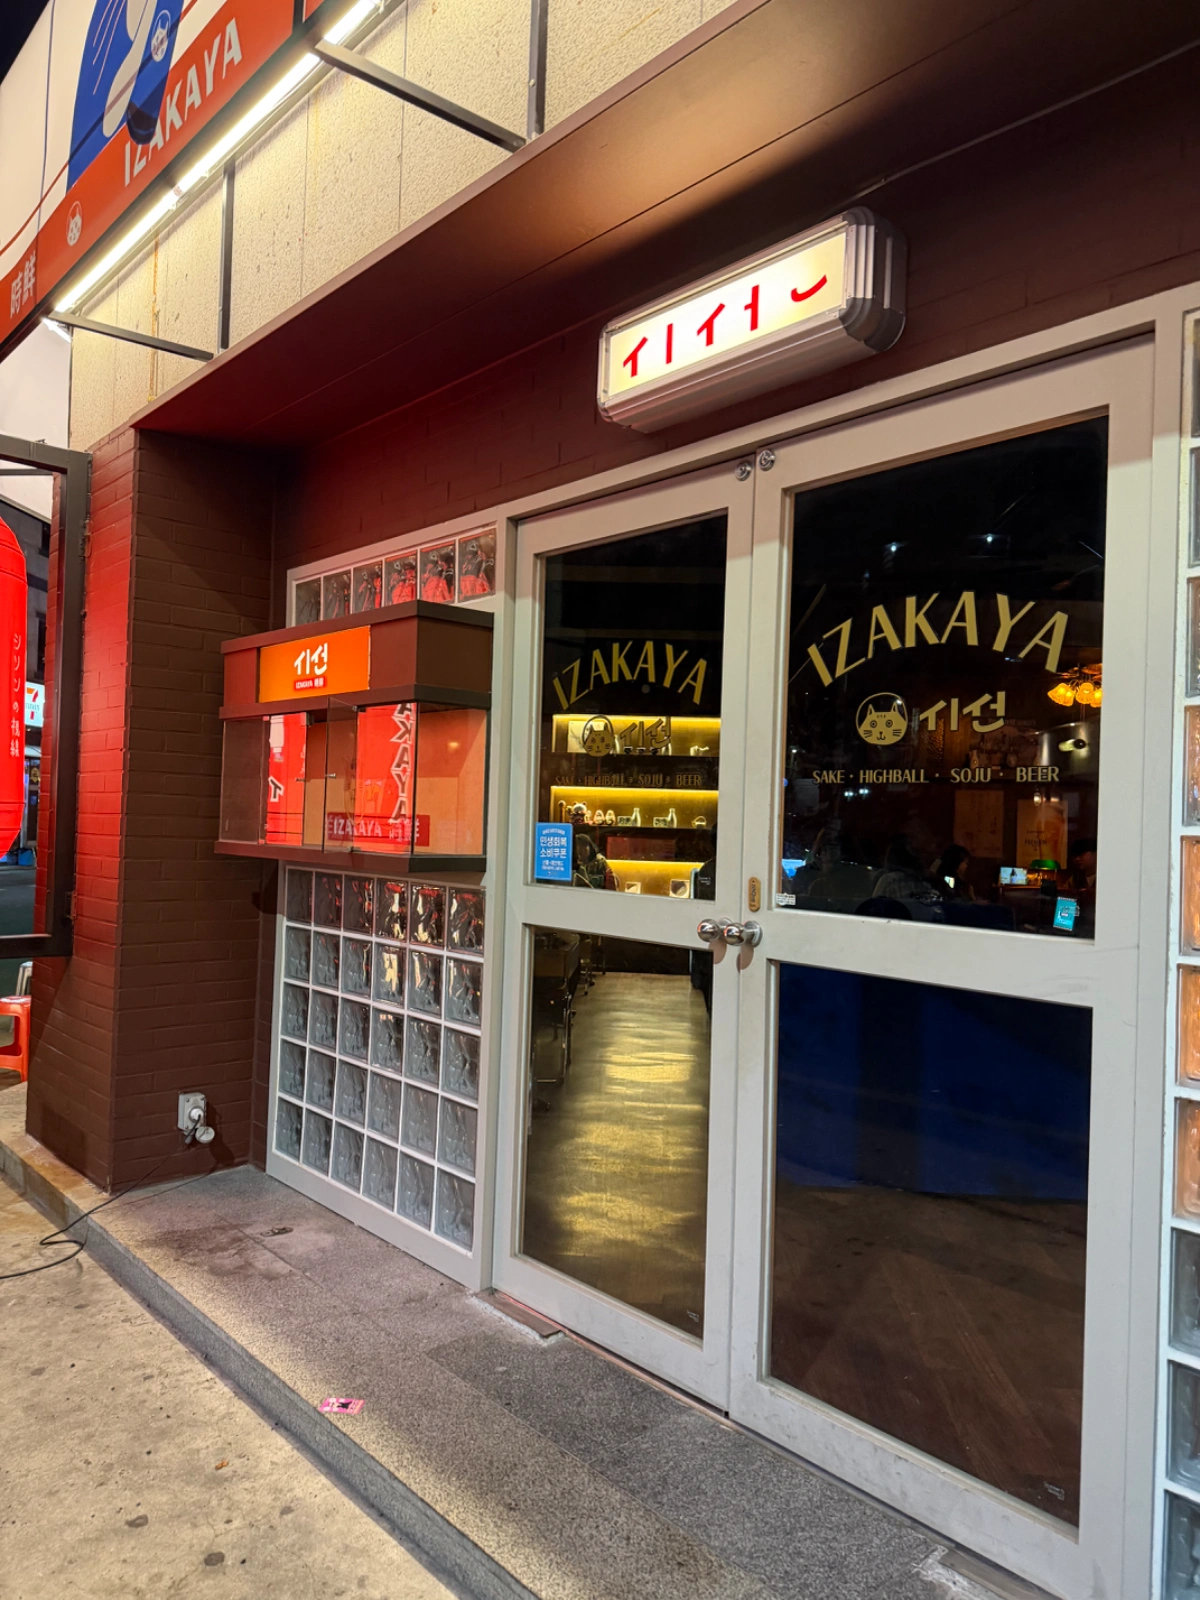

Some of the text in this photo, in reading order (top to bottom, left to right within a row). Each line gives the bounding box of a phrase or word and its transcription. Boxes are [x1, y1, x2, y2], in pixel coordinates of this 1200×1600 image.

[807, 590, 1069, 688] IZAKAYA
[552, 640, 707, 710] IZAKAYA
[919, 691, 1006, 733] 시선
[555, 773, 702, 787] SAKE HIGHBALL SOJU BEER
[812, 766, 1060, 784] SAKE HIGHBALL SOJU BEER
[540, 848, 567, 859] 소비쿠폰
